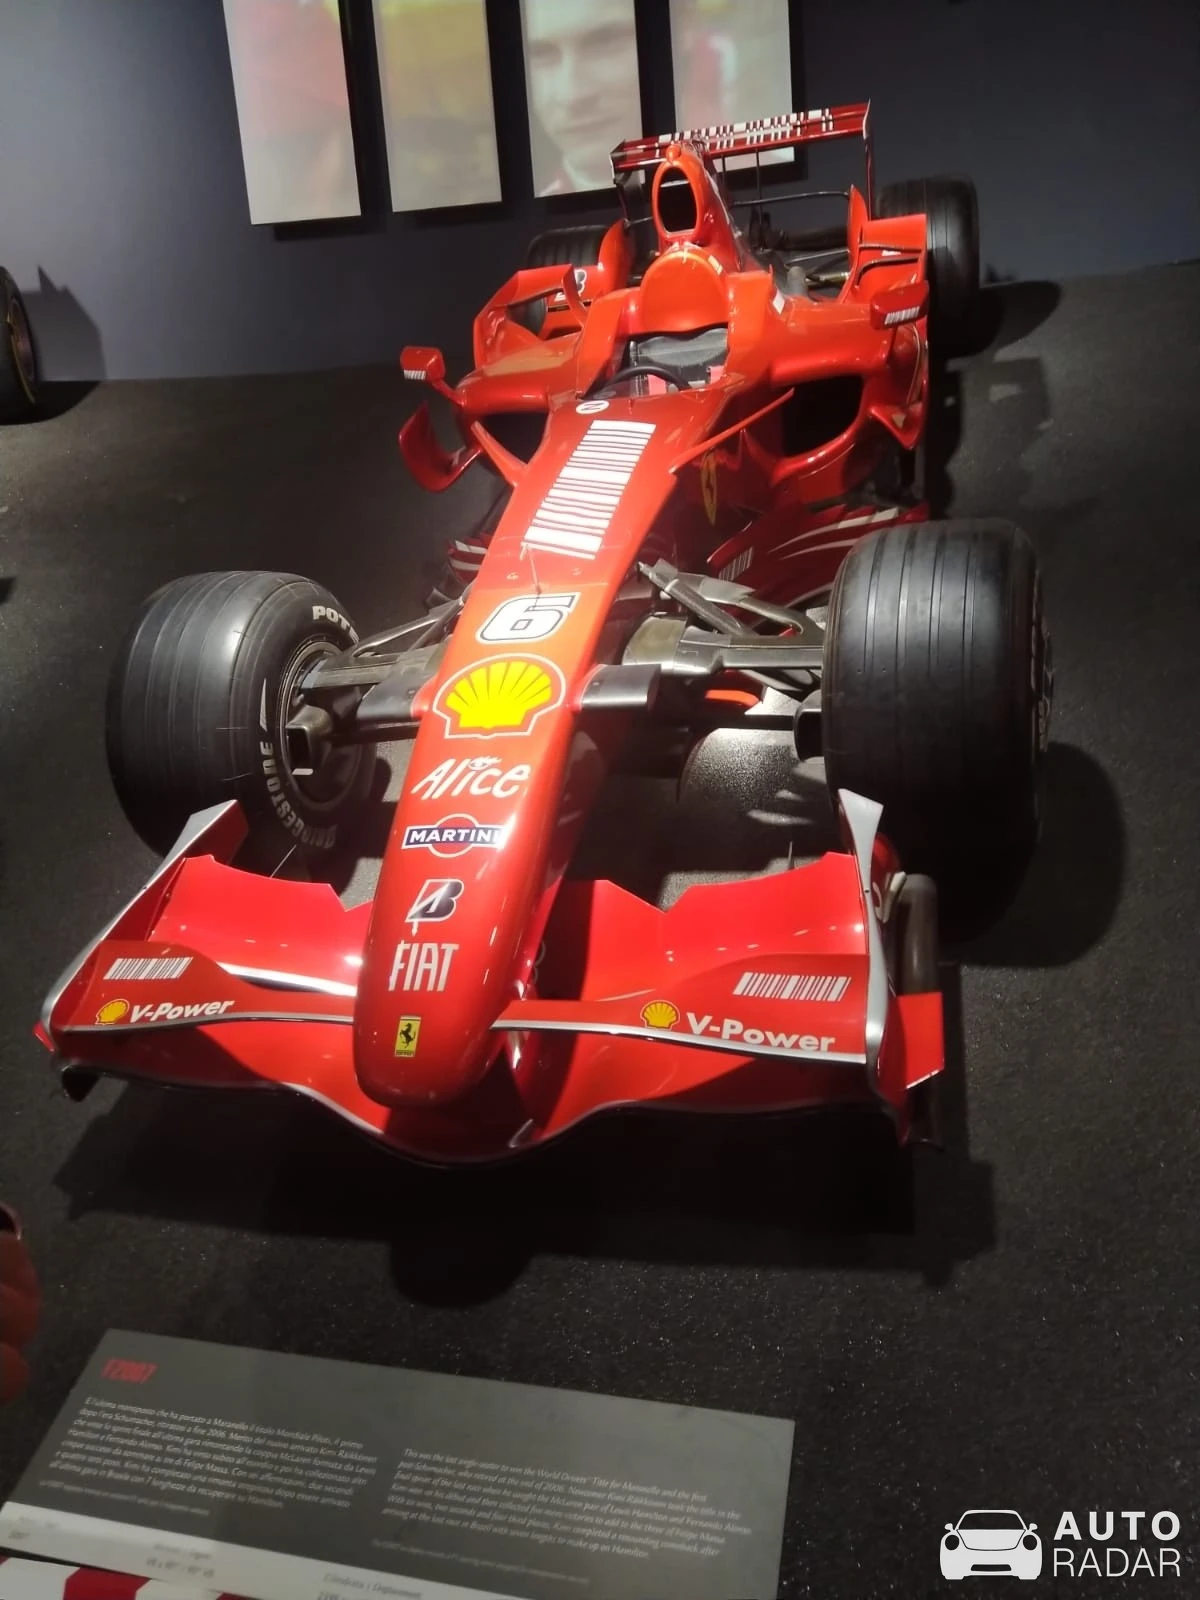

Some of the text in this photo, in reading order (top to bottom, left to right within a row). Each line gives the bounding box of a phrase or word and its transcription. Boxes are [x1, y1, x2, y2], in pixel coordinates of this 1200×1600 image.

[477, 592, 581, 644] 6
[411, 756, 532, 800] Alice
[388, 940, 459, 991] FIAT
[130, 1000, 235, 1023] V-Power
[686, 1012, 835, 1052] V-Power
